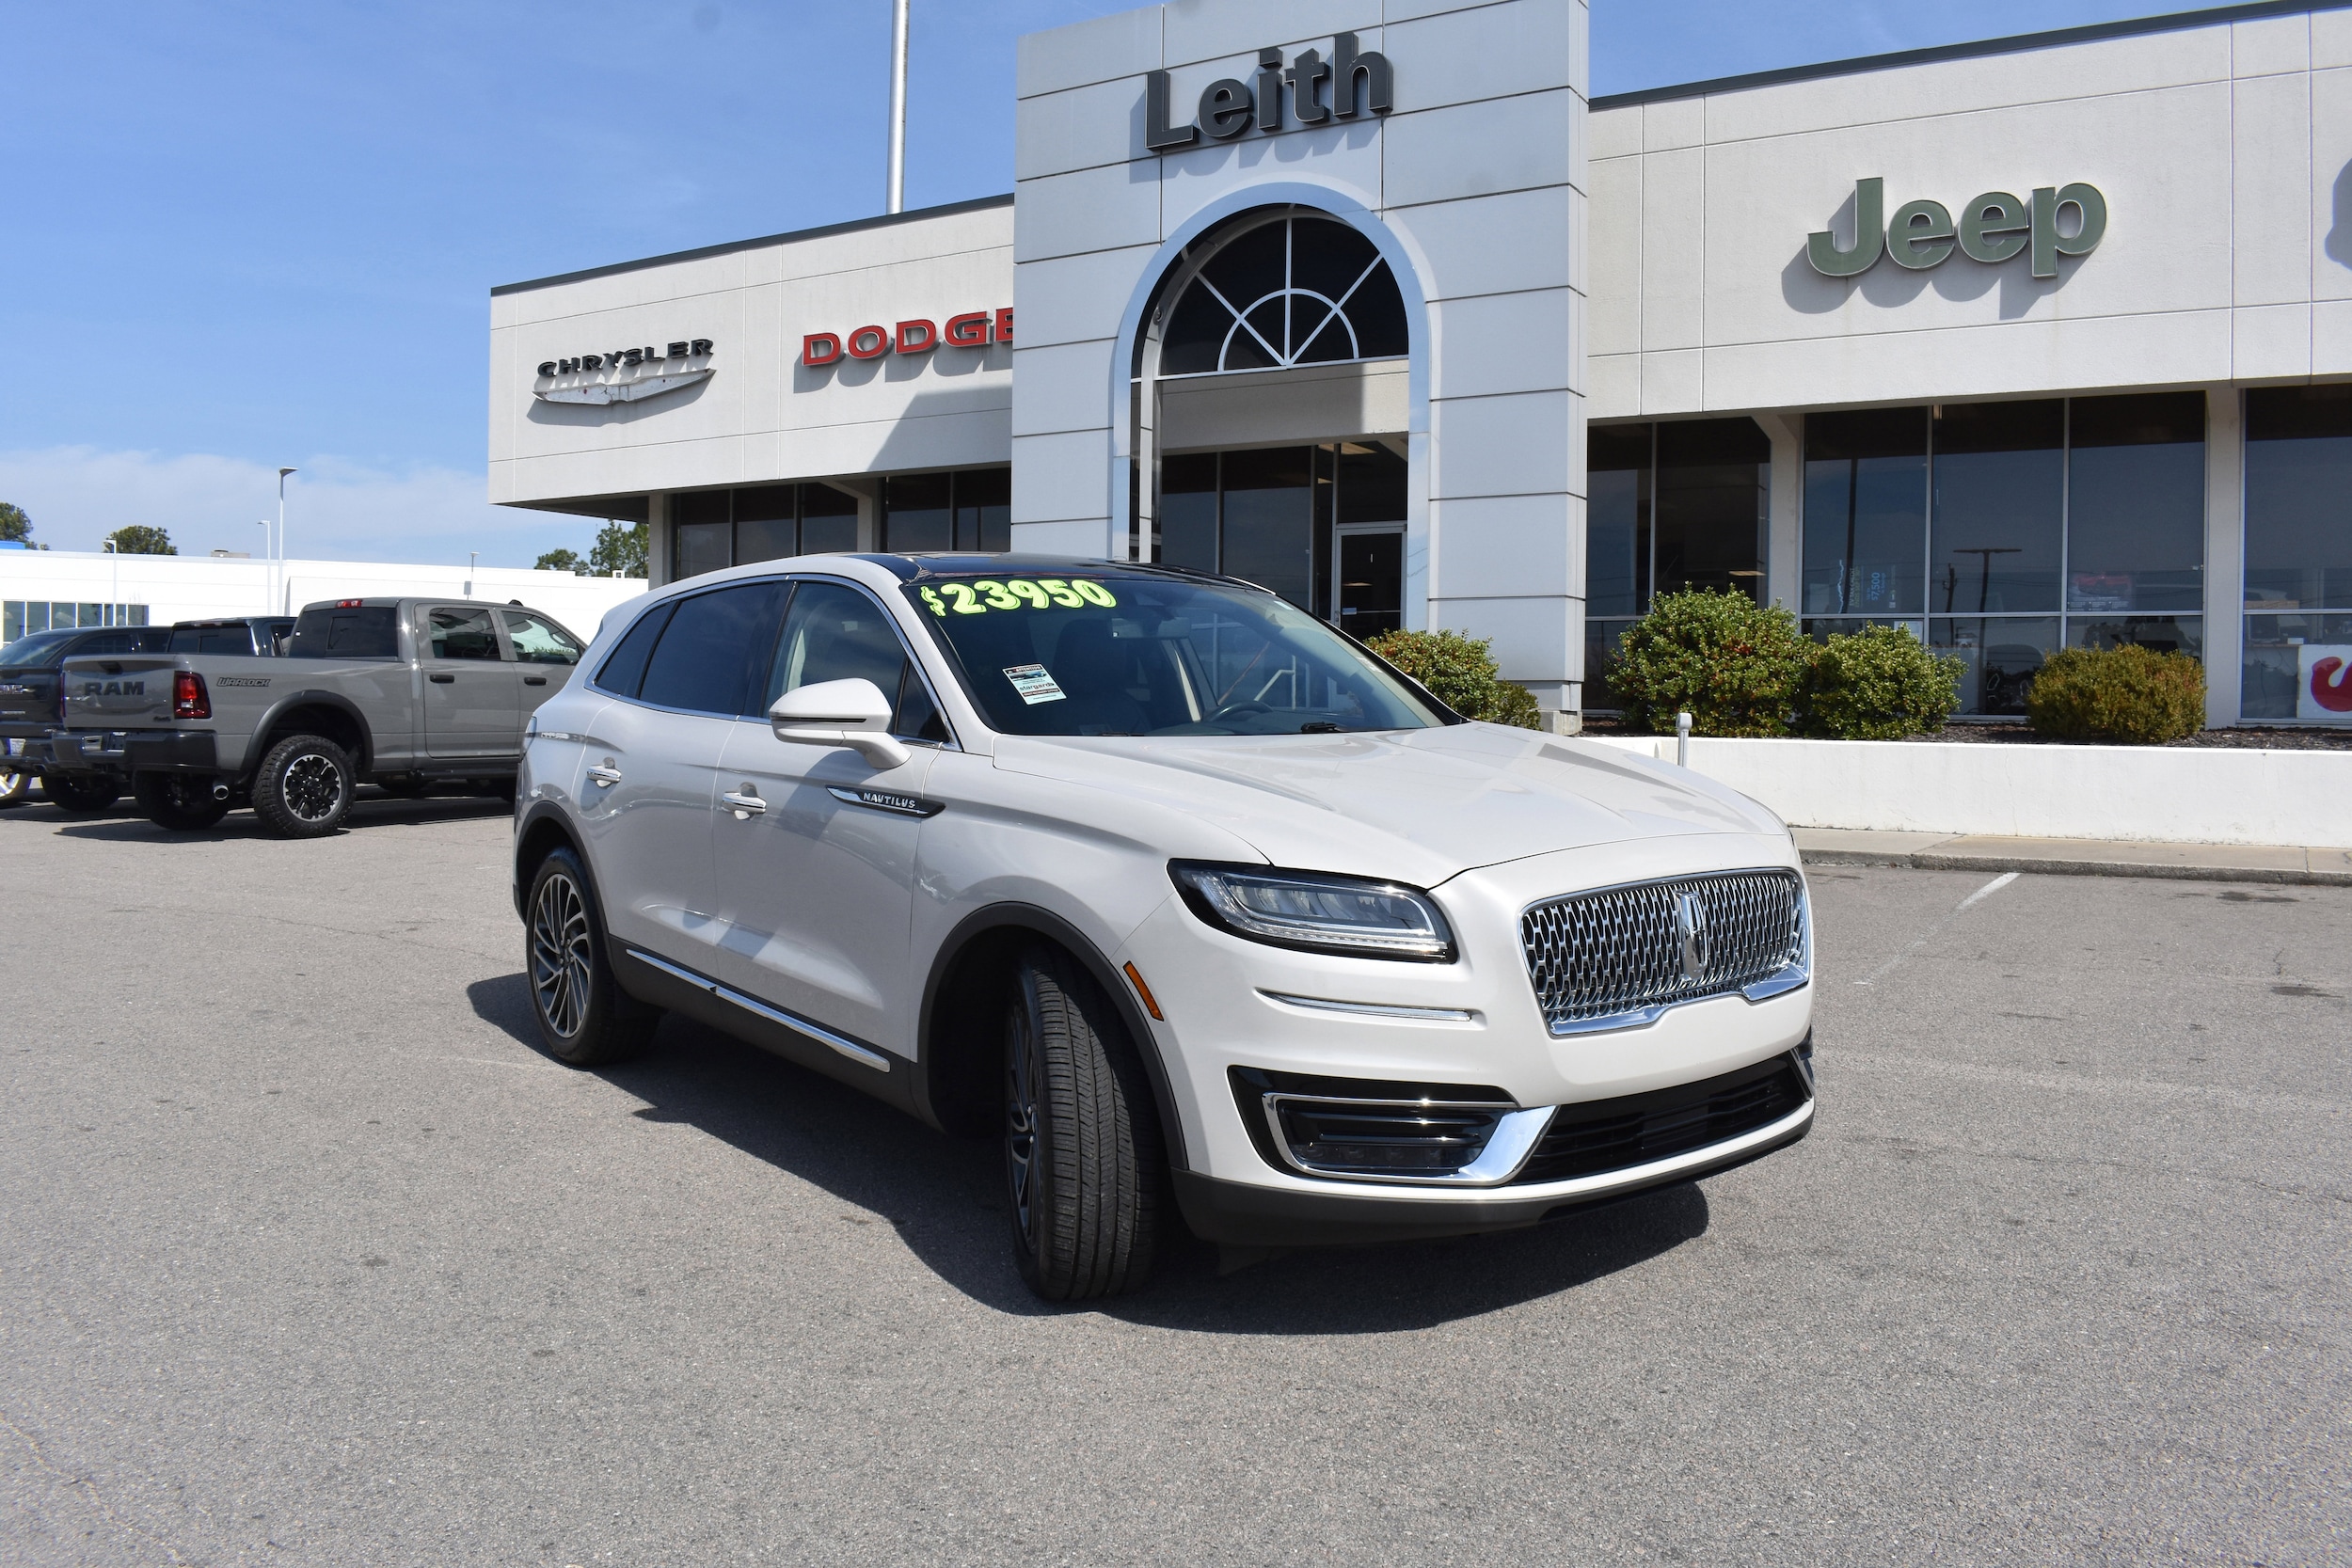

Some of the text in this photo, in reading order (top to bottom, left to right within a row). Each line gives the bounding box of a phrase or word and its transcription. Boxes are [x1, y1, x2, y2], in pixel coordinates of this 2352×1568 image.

[1144, 31, 1394, 152] Leith
[1806, 176, 2107, 280] Jeep
[536, 337, 715, 378] CHRYSLER
[920, 579, 1118, 617] $23950
[85, 681, 145, 696] RAM
[216, 676, 272, 688] WARLOCK
[863, 792, 916, 809] NAUTILUS
